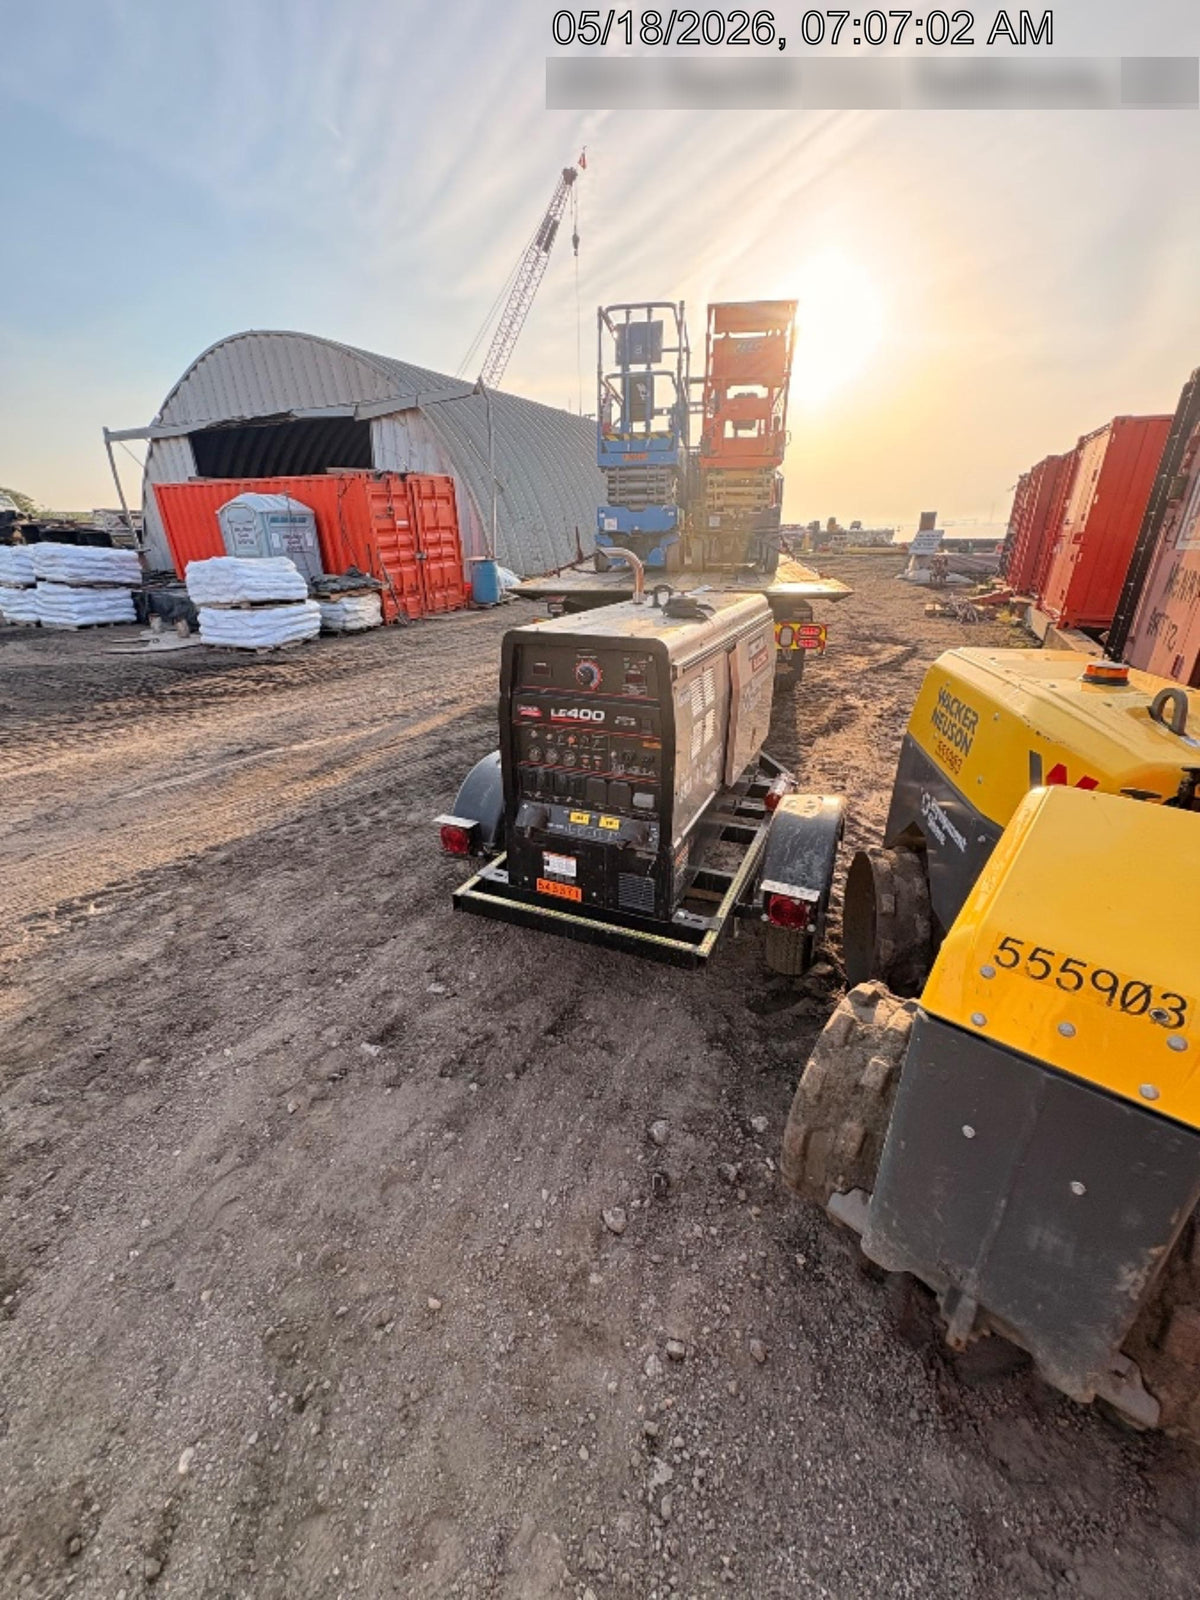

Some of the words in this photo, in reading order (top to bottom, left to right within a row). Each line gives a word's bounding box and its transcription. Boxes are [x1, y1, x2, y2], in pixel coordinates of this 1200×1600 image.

[931, 706, 974, 758] NEUSON
[938, 686, 980, 735] WACKER
[993, 936, 1188, 1030] 555903
